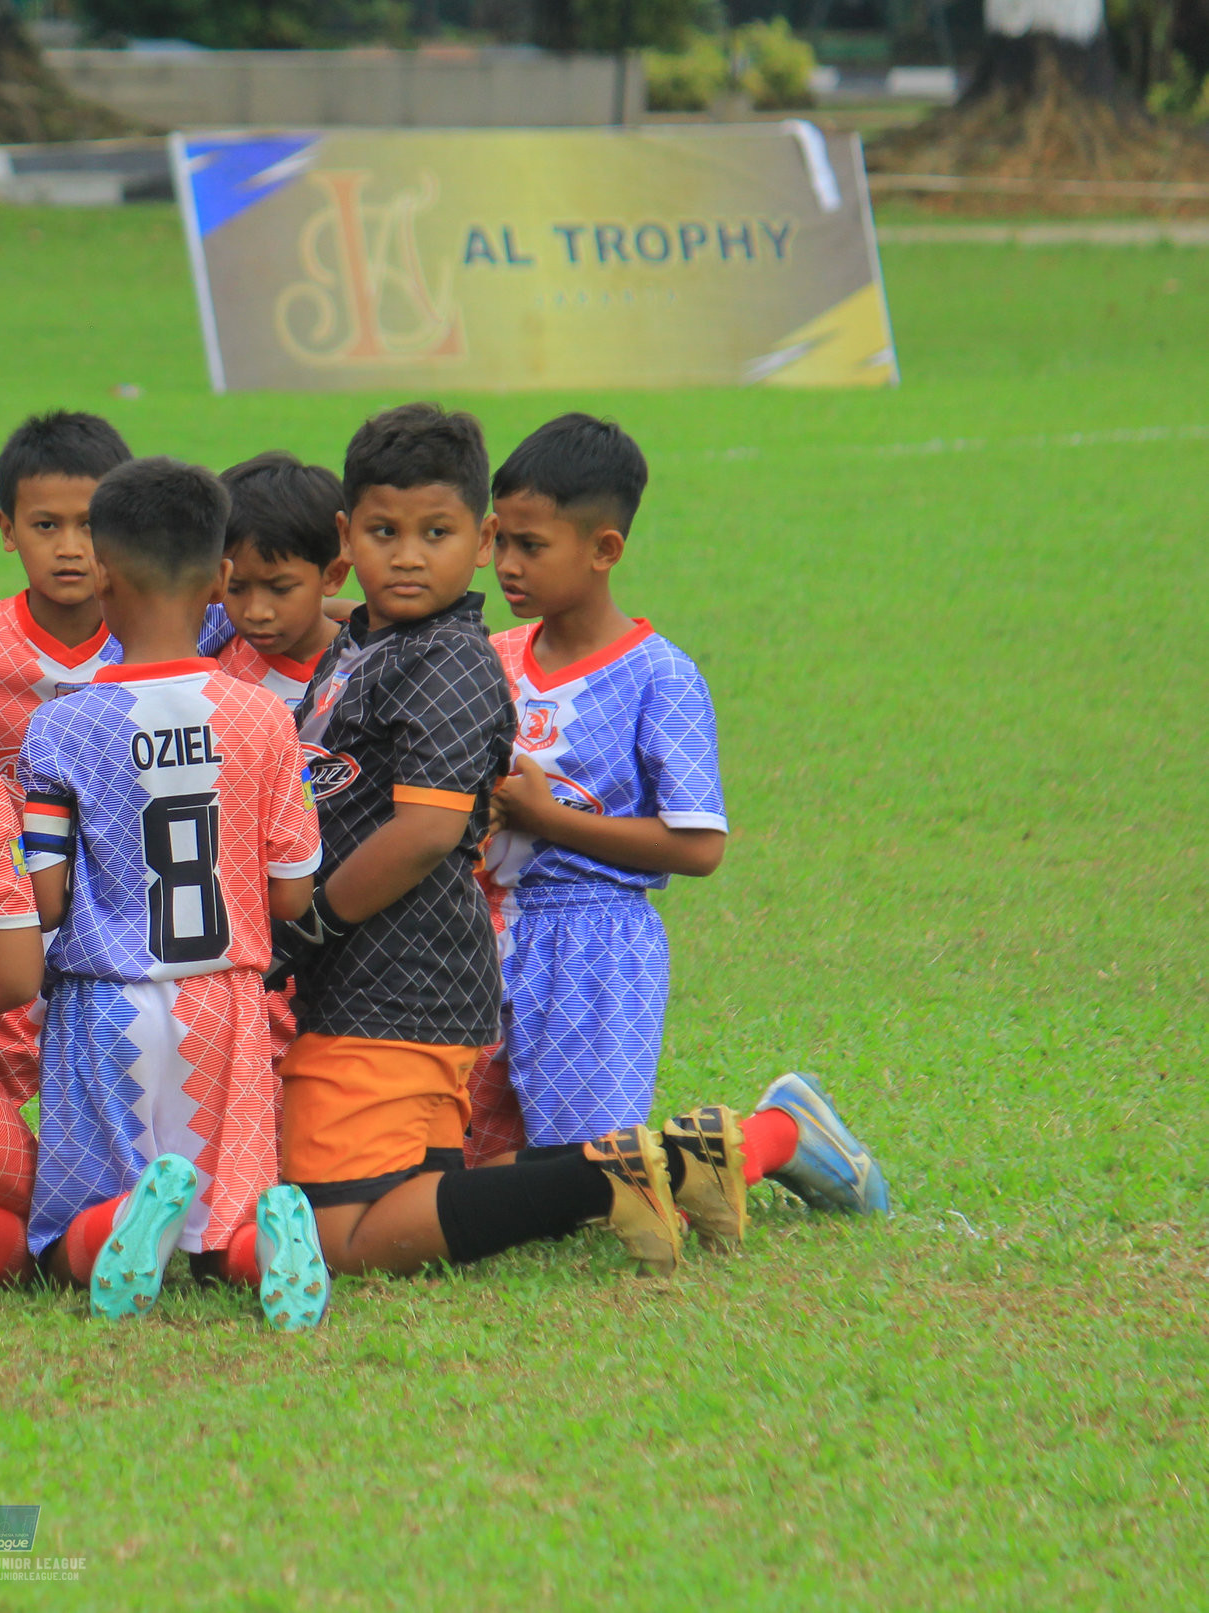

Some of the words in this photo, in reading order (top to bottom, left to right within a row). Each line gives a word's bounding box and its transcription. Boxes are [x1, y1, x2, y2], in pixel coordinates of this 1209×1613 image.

[462, 222, 534, 266] AL
[553, 219, 795, 264] TROPHY
[131, 724, 224, 771] OZIEL
[142, 790, 231, 964] 8
